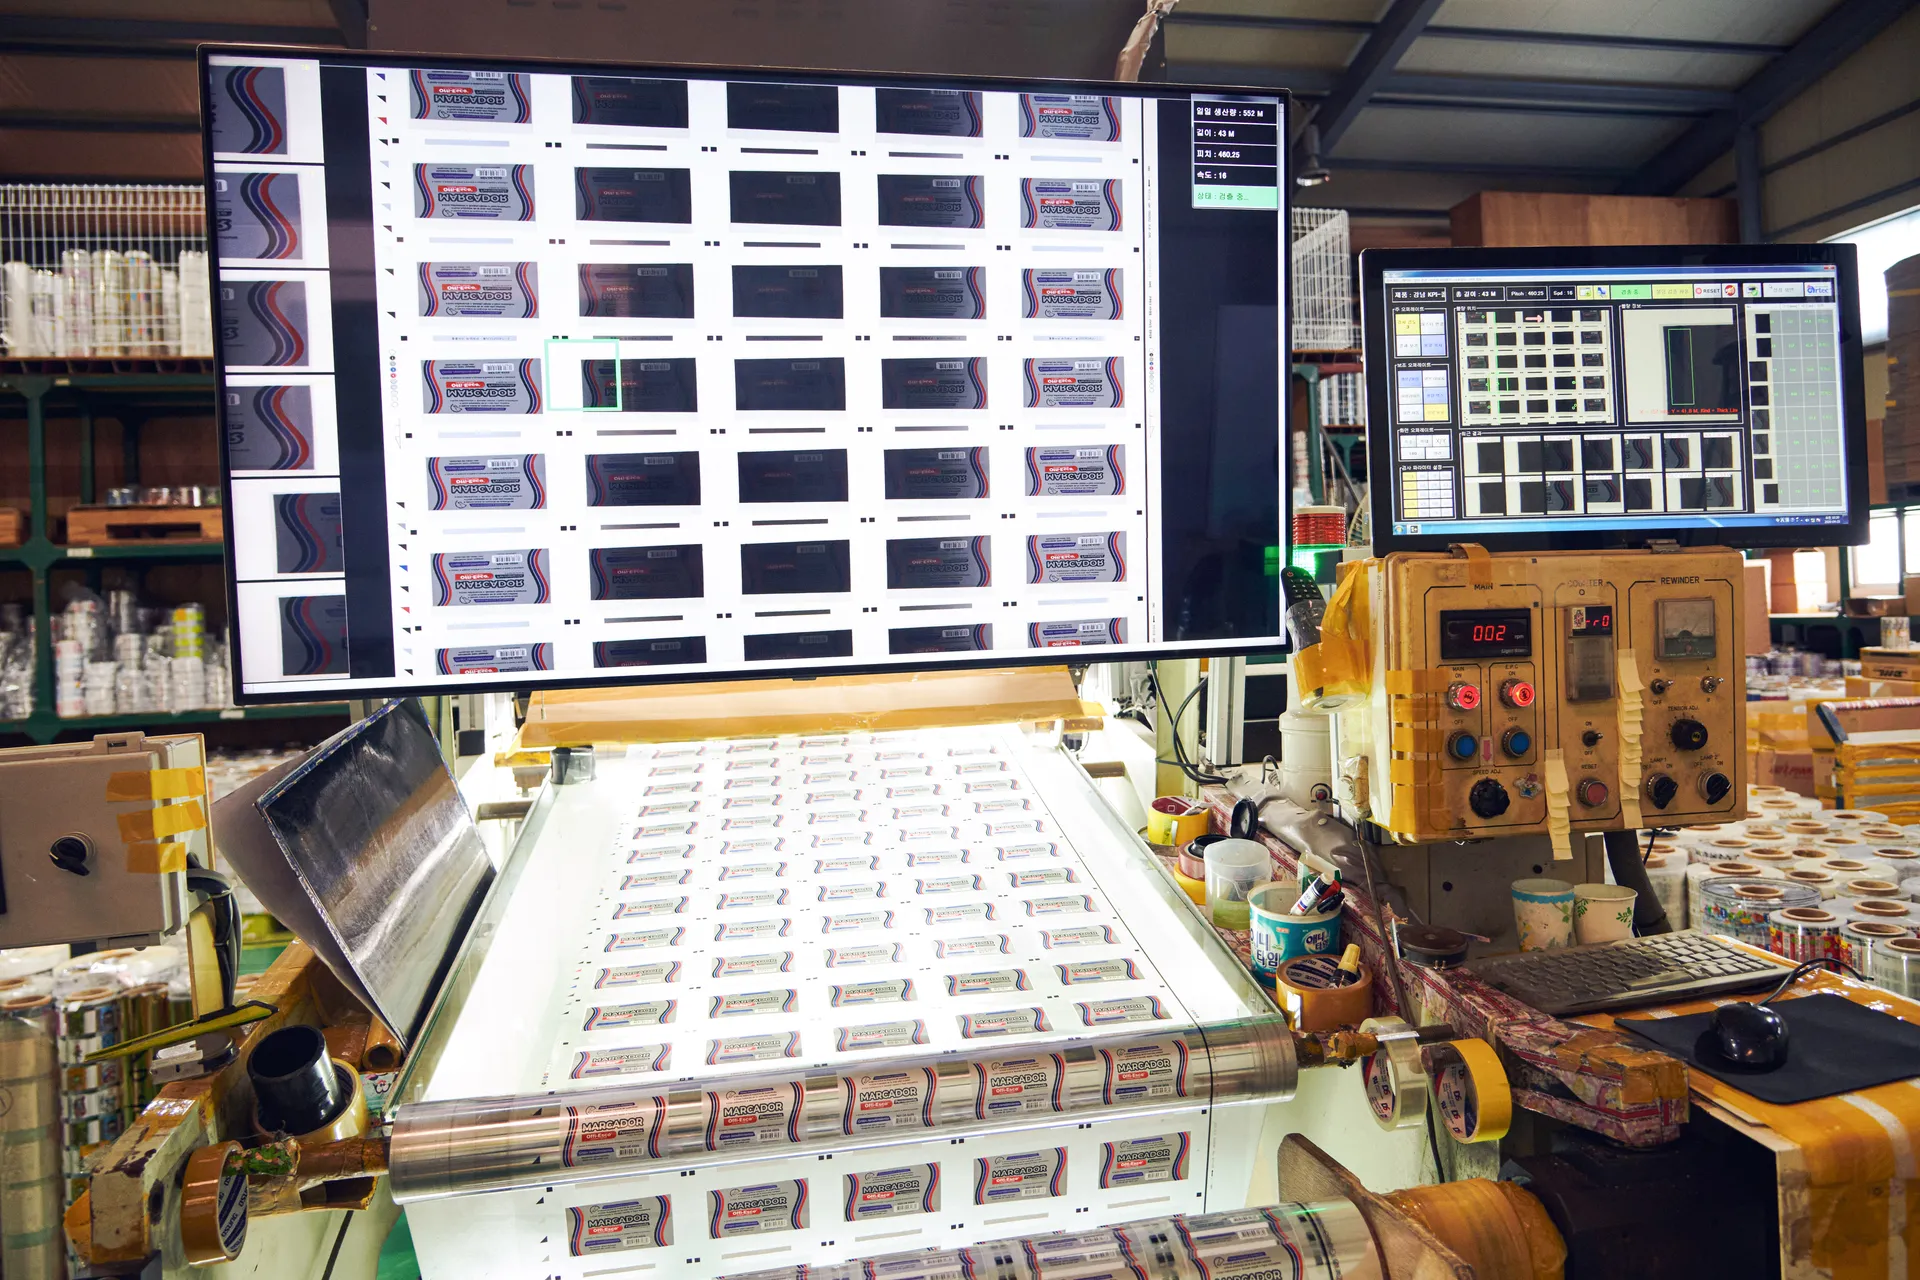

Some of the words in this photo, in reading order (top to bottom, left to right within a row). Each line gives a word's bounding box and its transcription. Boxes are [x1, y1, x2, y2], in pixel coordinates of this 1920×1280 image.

[1196, 106, 1211, 116] 일일
[1213, 107, 1237, 117] 생산량
[1243, 109, 1256, 117] 552
[1196, 128, 1212, 137] 길이
[1217, 129, 1227, 137] 43
[1196, 149, 1212, 158] 피치
[1217, 150, 1241, 159] 460.25
[1196, 170, 1212, 179] 속도
[1218, 171, 1228, 179] 16
[1197, 192, 1212, 200] 상태
[1569, 579, 1604, 588] COUTER
[1660, 576, 1700, 584] REWINDER
[1473, 625, 1506, 641] 002
[1305, 930, 1325, 944] 애니
[1256, 948, 1281, 968] 타임
[1117, 1059, 1171, 1073] MARCADOR
[991, 1072, 1047, 1087] MARCADOR
[860, 1086, 917, 1102] MARCADOR
[723, 1102, 783, 1117] MARCADOR
[582, 1117, 644, 1133] MARCADOR
[1117, 1149, 1170, 1162] MARCADOR
[992, 1165, 1047, 1178] MARCADOR
[862, 1180, 919, 1194] MARCADOR
[728, 1197, 787, 1211] MARCADOR
[588, 1213, 650, 1228] MARCADOR
[1214, 1269, 1283, 1280] CADOR
